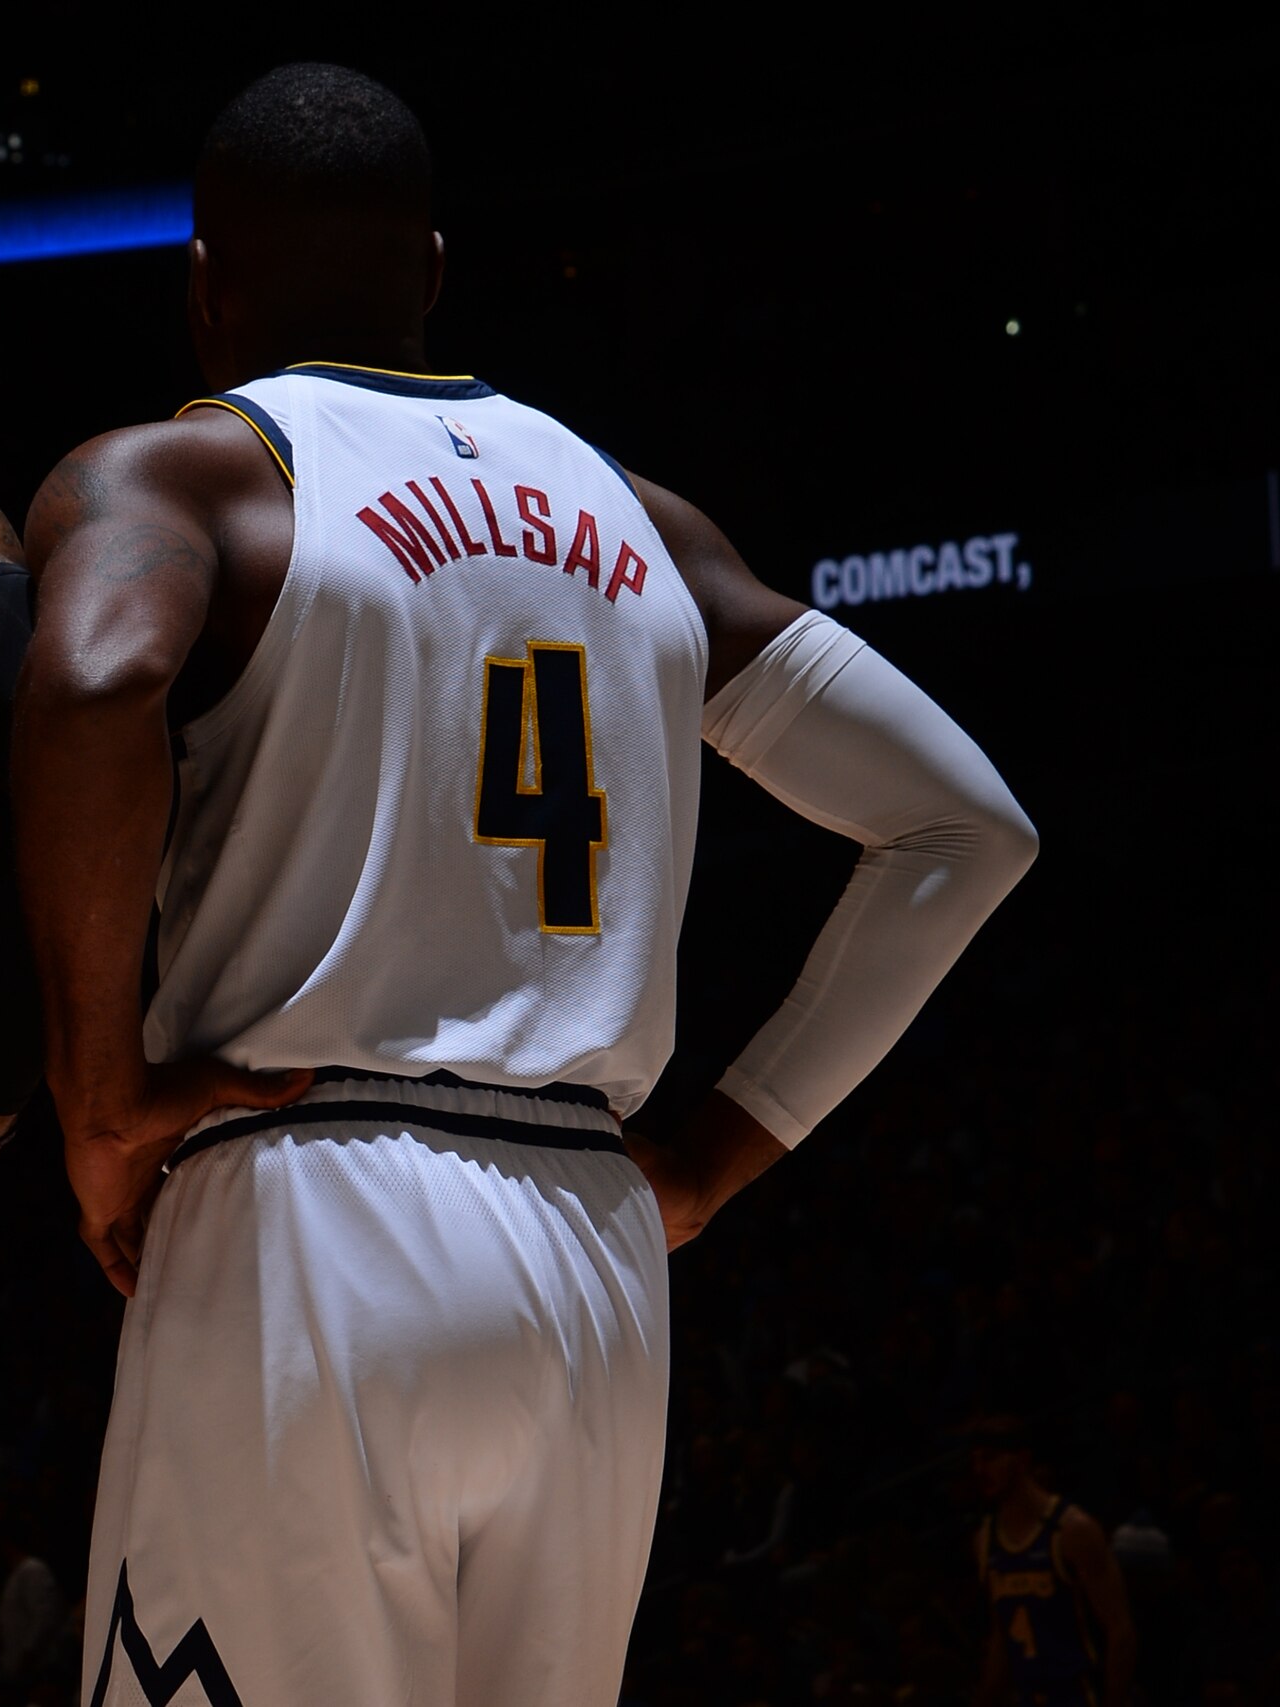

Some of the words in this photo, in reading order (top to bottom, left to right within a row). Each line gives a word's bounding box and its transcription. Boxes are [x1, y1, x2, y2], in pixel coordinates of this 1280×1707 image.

[356, 477, 648, 604] MILLSAP
[811, 532, 1032, 609] COMCAST,
[474, 640, 608, 934] 4
